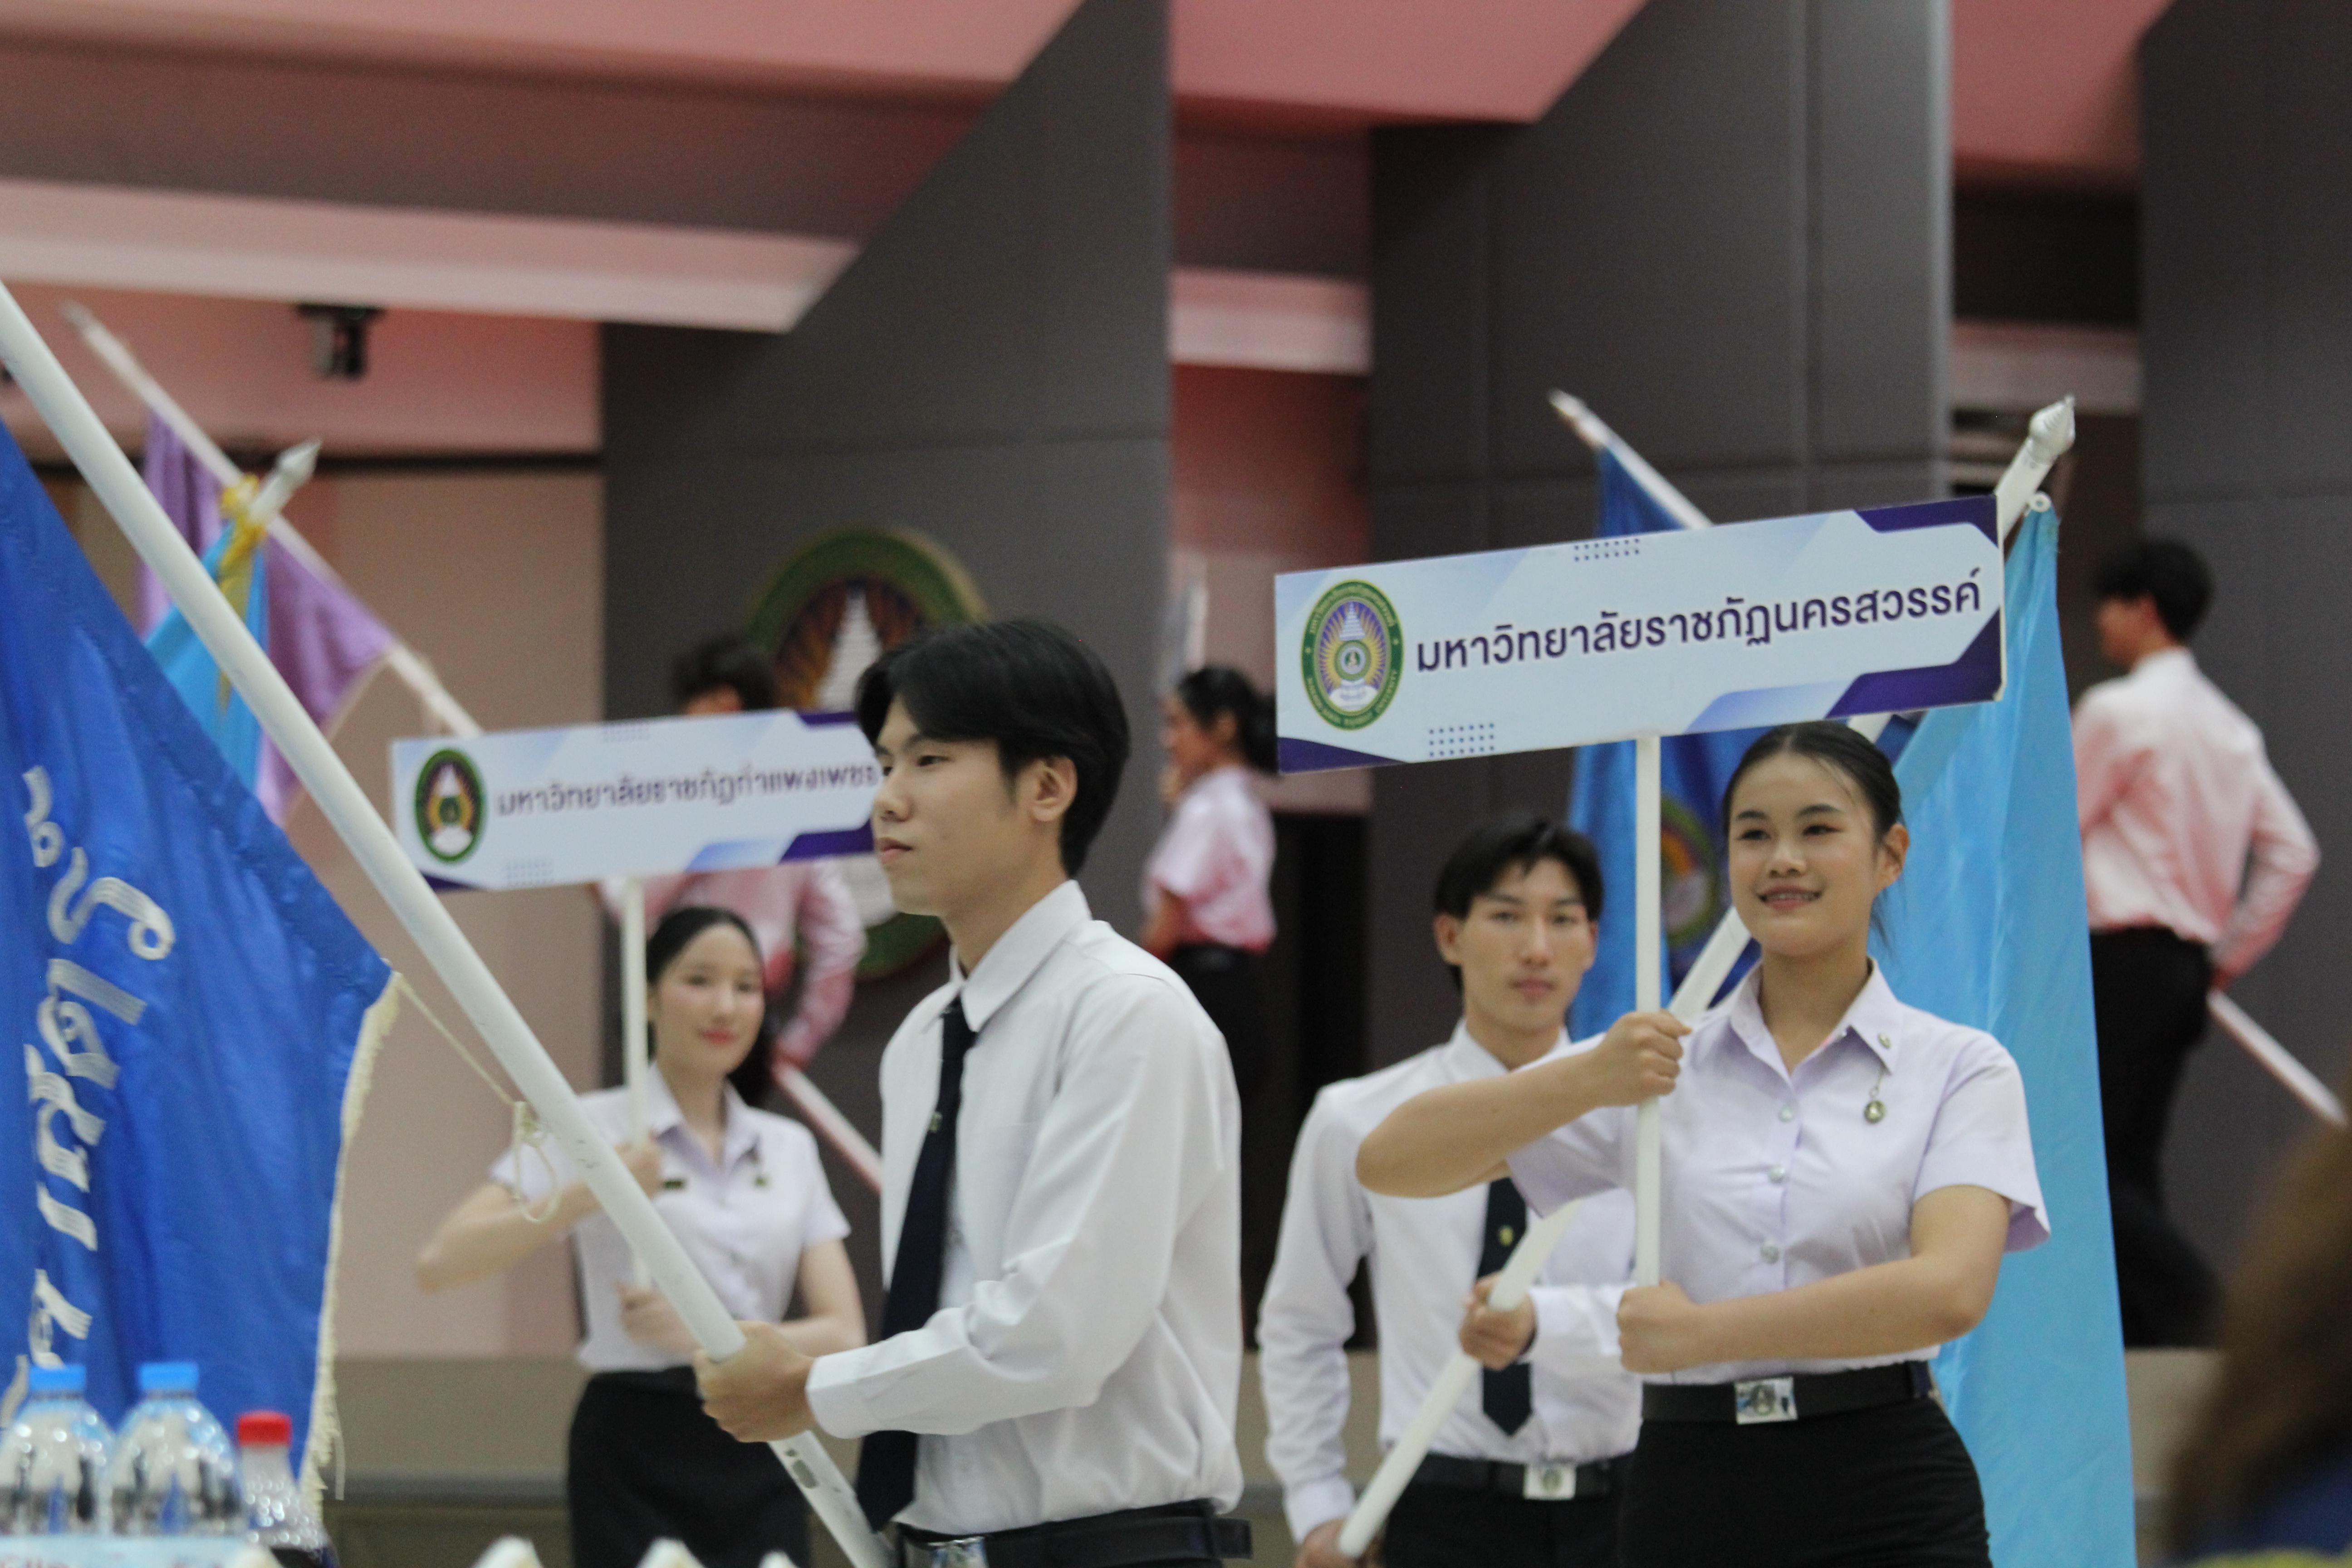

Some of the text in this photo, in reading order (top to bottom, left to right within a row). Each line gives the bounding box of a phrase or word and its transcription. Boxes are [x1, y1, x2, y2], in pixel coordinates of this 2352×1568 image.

[1417, 566, 1980, 672] มหาวิทยาลัยราชภัฏนครสวรรค์
